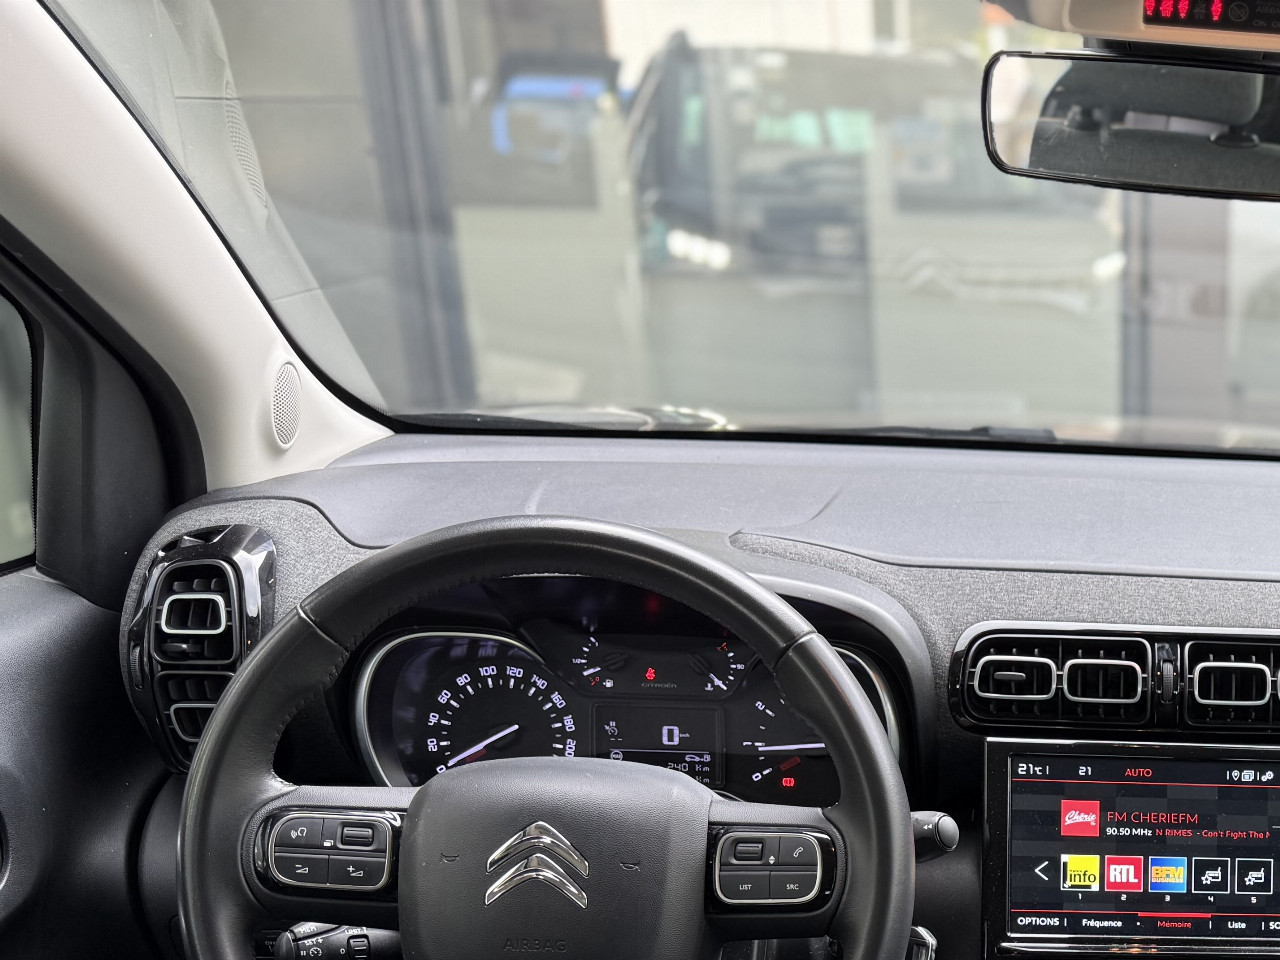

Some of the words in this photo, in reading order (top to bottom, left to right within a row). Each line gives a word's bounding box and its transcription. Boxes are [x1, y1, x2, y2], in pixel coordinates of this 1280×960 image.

[479, 665, 497, 676] 100
[506, 665, 524, 678] 120
[456, 673, 471, 686] 80
[531, 674, 548, 690] 140
[438, 689, 452, 704] 60
[550, 691, 567, 709] 160
[755, 701, 765, 711] 2
[427, 712, 440, 726] 40
[563, 714, 576, 732] 180
[662, 725, 680, 746] 0
[427, 738, 438, 752] 20
[564, 739, 577, 757] 200
[752, 772, 762, 781] 0
[1078, 766, 1092, 776] 21
[1125, 768, 1153, 777] AUTO
[1107, 811, 1127, 822] FM
[1130, 812, 1199, 824] CHERIEFM
[1106, 827, 1131, 836] 90.50
[1132, 828, 1153, 836] MHz
[1165, 829, 1193, 837] RIMES
[1202, 829, 1224, 838] Can't
[1225, 830, 1247, 840] Fight
[1069, 869, 1097, 883] info
[1109, 864, 1139, 883] RTL
[1151, 866, 1184, 877] BFM
[1017, 916, 1060, 926] OPTIONS
[1082, 918, 1123, 928] Fréquence
[1157, 919, 1192, 928] Mémoire
[1228, 920, 1247, 929] Liste
[503, 939, 567, 953] AIRBAG
